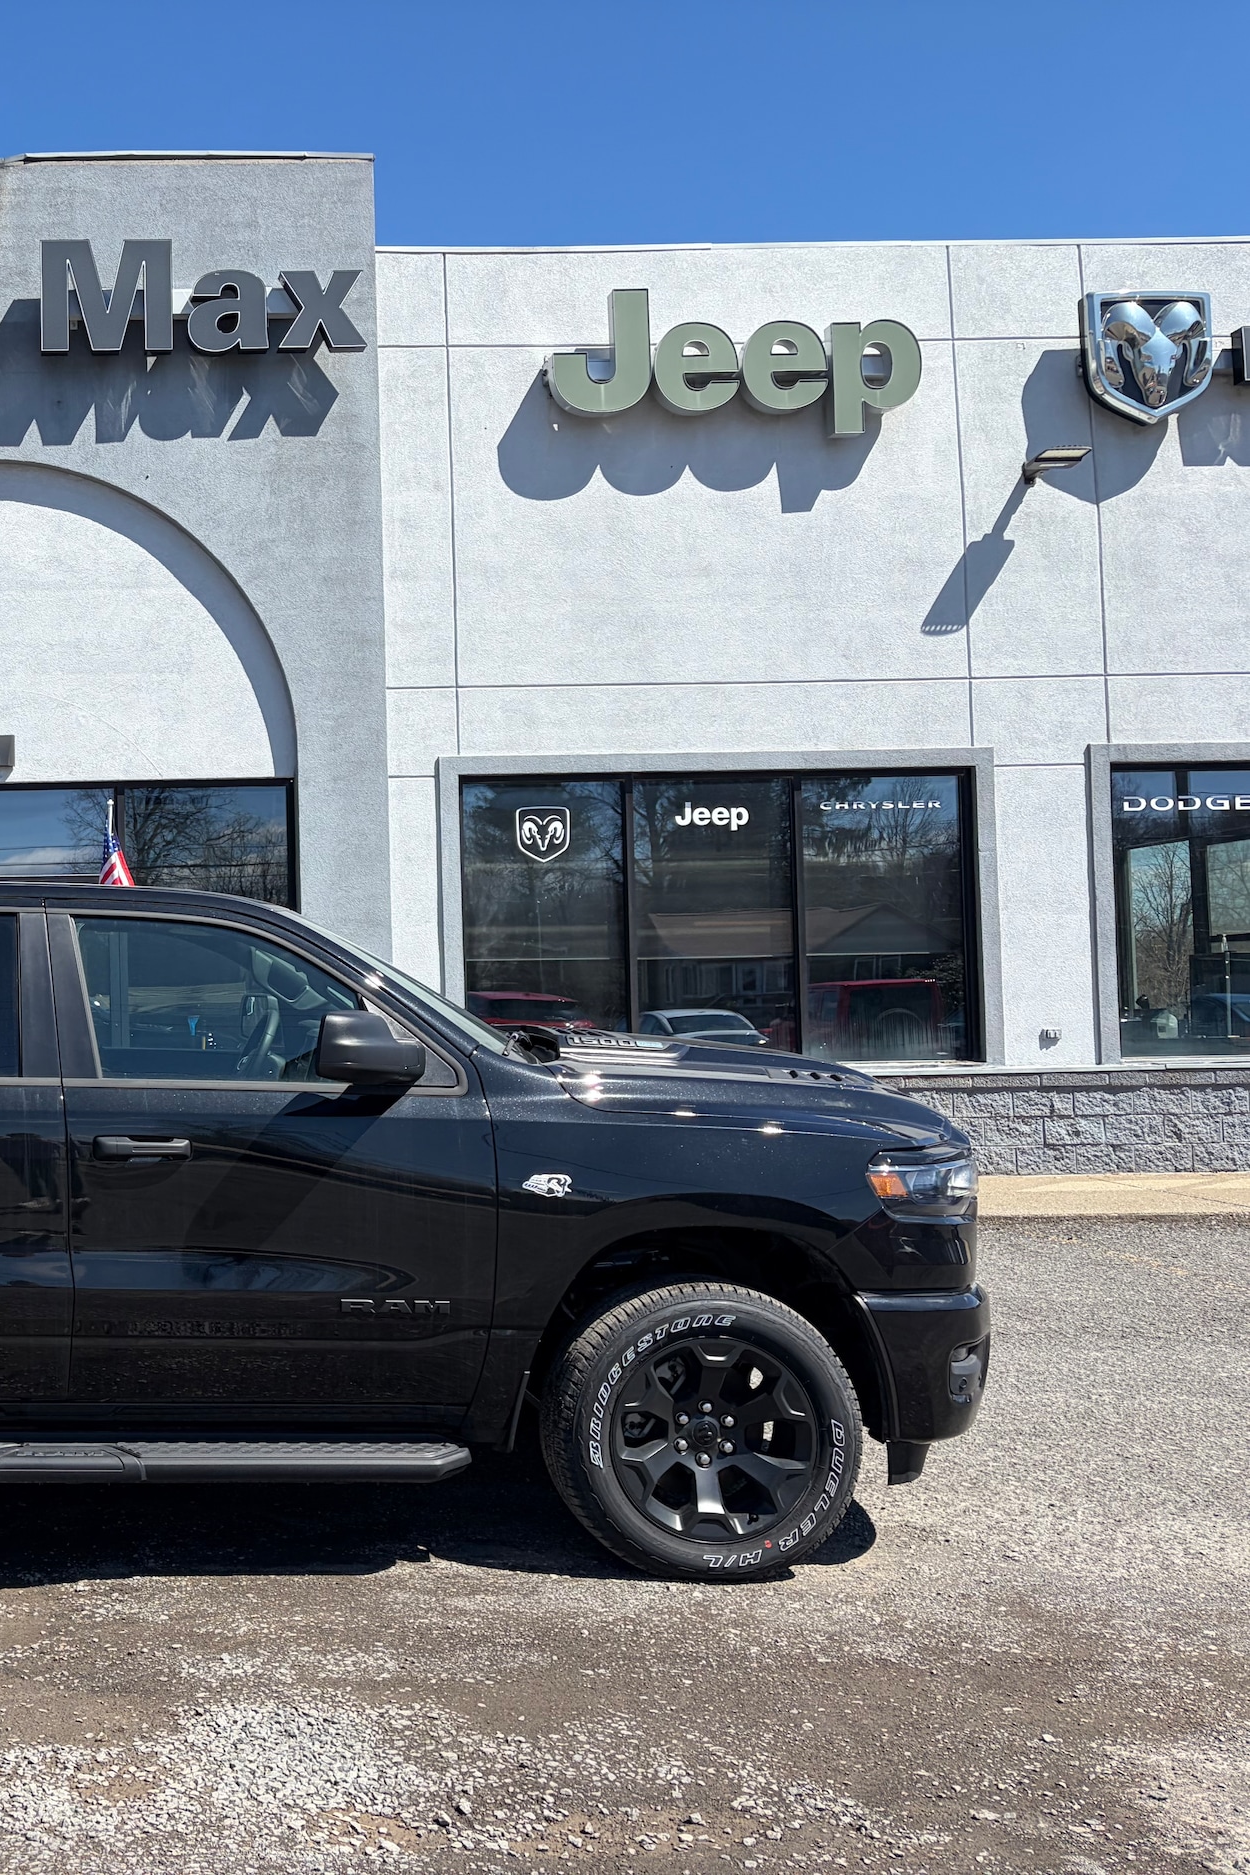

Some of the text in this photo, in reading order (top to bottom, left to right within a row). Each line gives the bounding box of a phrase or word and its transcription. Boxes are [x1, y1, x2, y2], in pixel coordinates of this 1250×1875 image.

[39, 238, 368, 355] Max
[547, 287, 923, 437] Jeep
[675, 801, 749, 831] Jeep
[819, 800, 941, 810] CHRYSLER
[1123, 795, 1250, 811] DODGE
[340, 1298, 450, 1314] RAM
[589, 1314, 737, 1470] BRIDGESTONE
[702, 1418, 846, 1568] DUELER H/L
